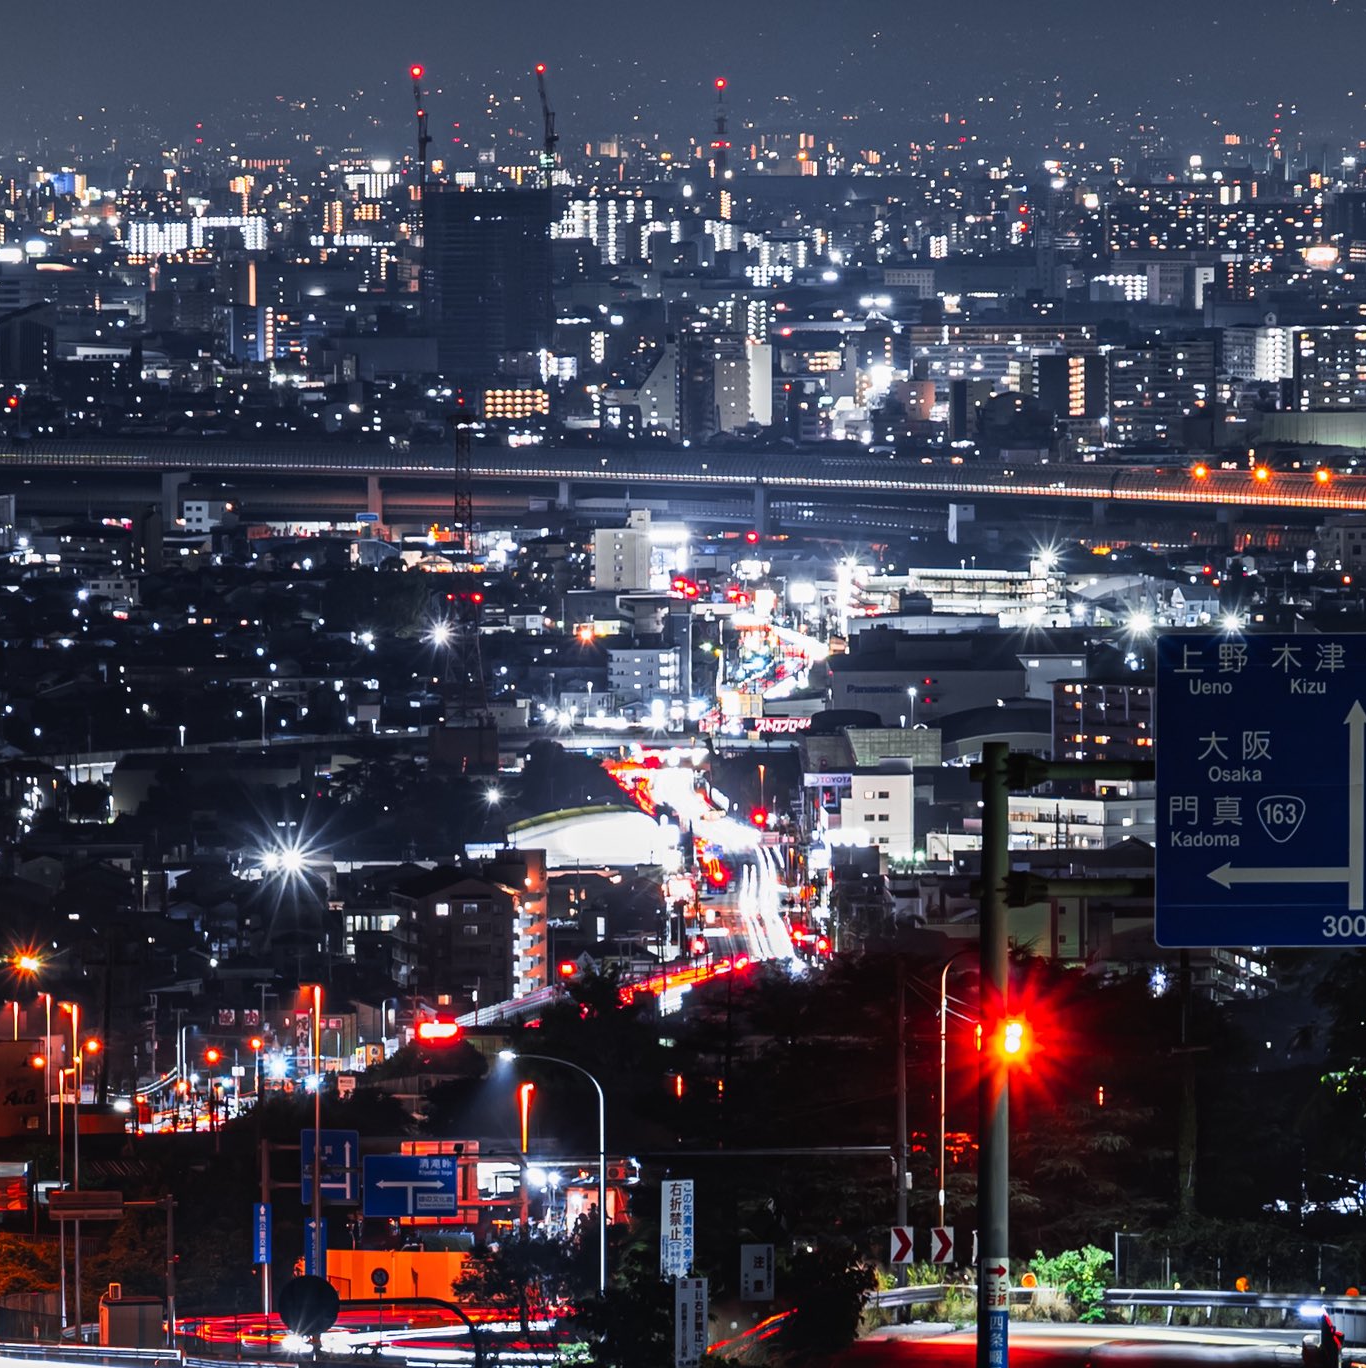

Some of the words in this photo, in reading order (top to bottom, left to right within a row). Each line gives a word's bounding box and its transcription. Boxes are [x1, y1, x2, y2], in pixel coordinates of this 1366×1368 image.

[1173, 643, 1248, 673] 上野
[1271, 642, 1346, 673] 木津
[847, 684, 903, 693] Panasonic
[1189, 679, 1233, 695] Ueno
[1290, 679, 1326, 694] Kizu
[1198, 731, 1272, 760] 大阪
[1208, 767, 1262, 782] Osaka
[1169, 796, 1243, 826] 門真
[1263, 803, 1297, 824] 163
[1171, 832, 1240, 847] Kadoma
